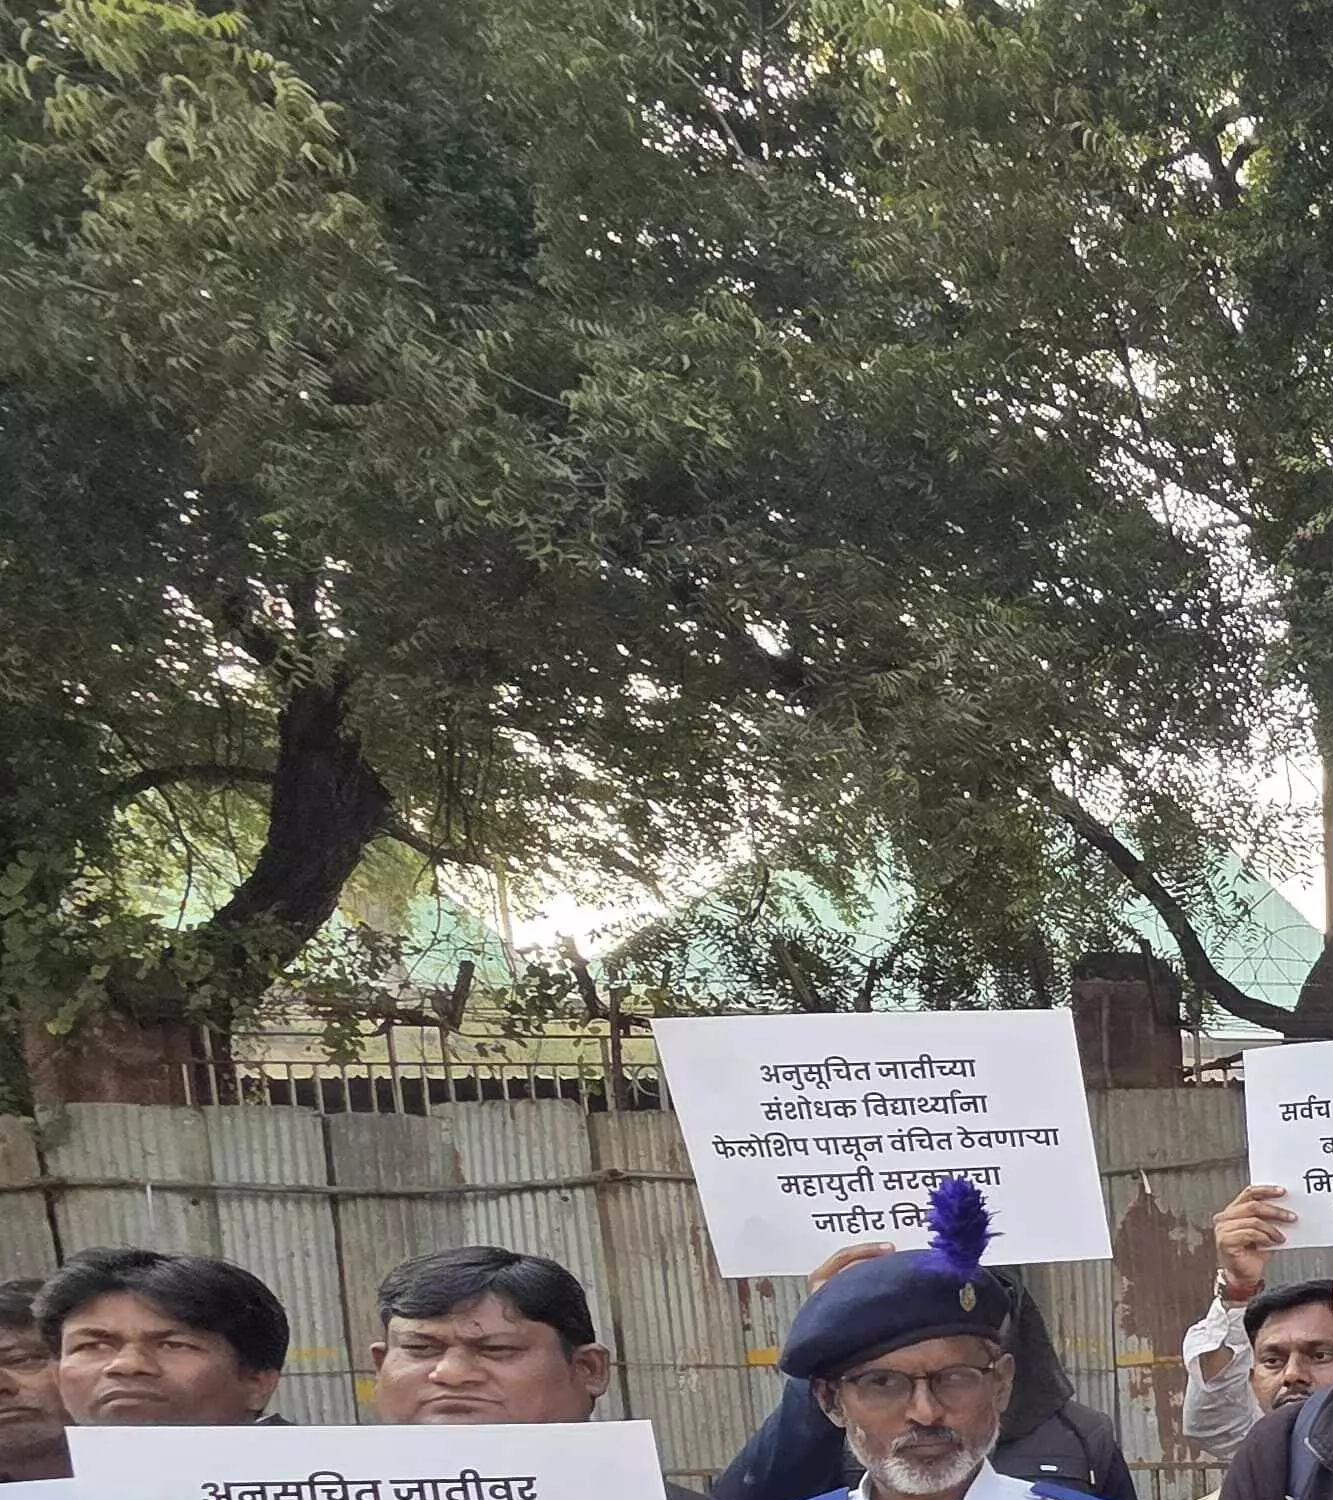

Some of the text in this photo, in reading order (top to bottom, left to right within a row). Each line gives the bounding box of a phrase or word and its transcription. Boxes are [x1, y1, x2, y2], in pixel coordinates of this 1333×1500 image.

[760, 1054, 975, 1090] अनुसूचित जातीच्या
[761, 1094, 856, 1121] संशोधक
[1279, 1095, 1330, 1122] सर्वच
[713, 1126, 1059, 1162] फेलोशिप पासून वंचित ठेवणाऱ्या
[777, 1166, 874, 1201] महायुती
[812, 1205, 885, 1234] जाहीर
